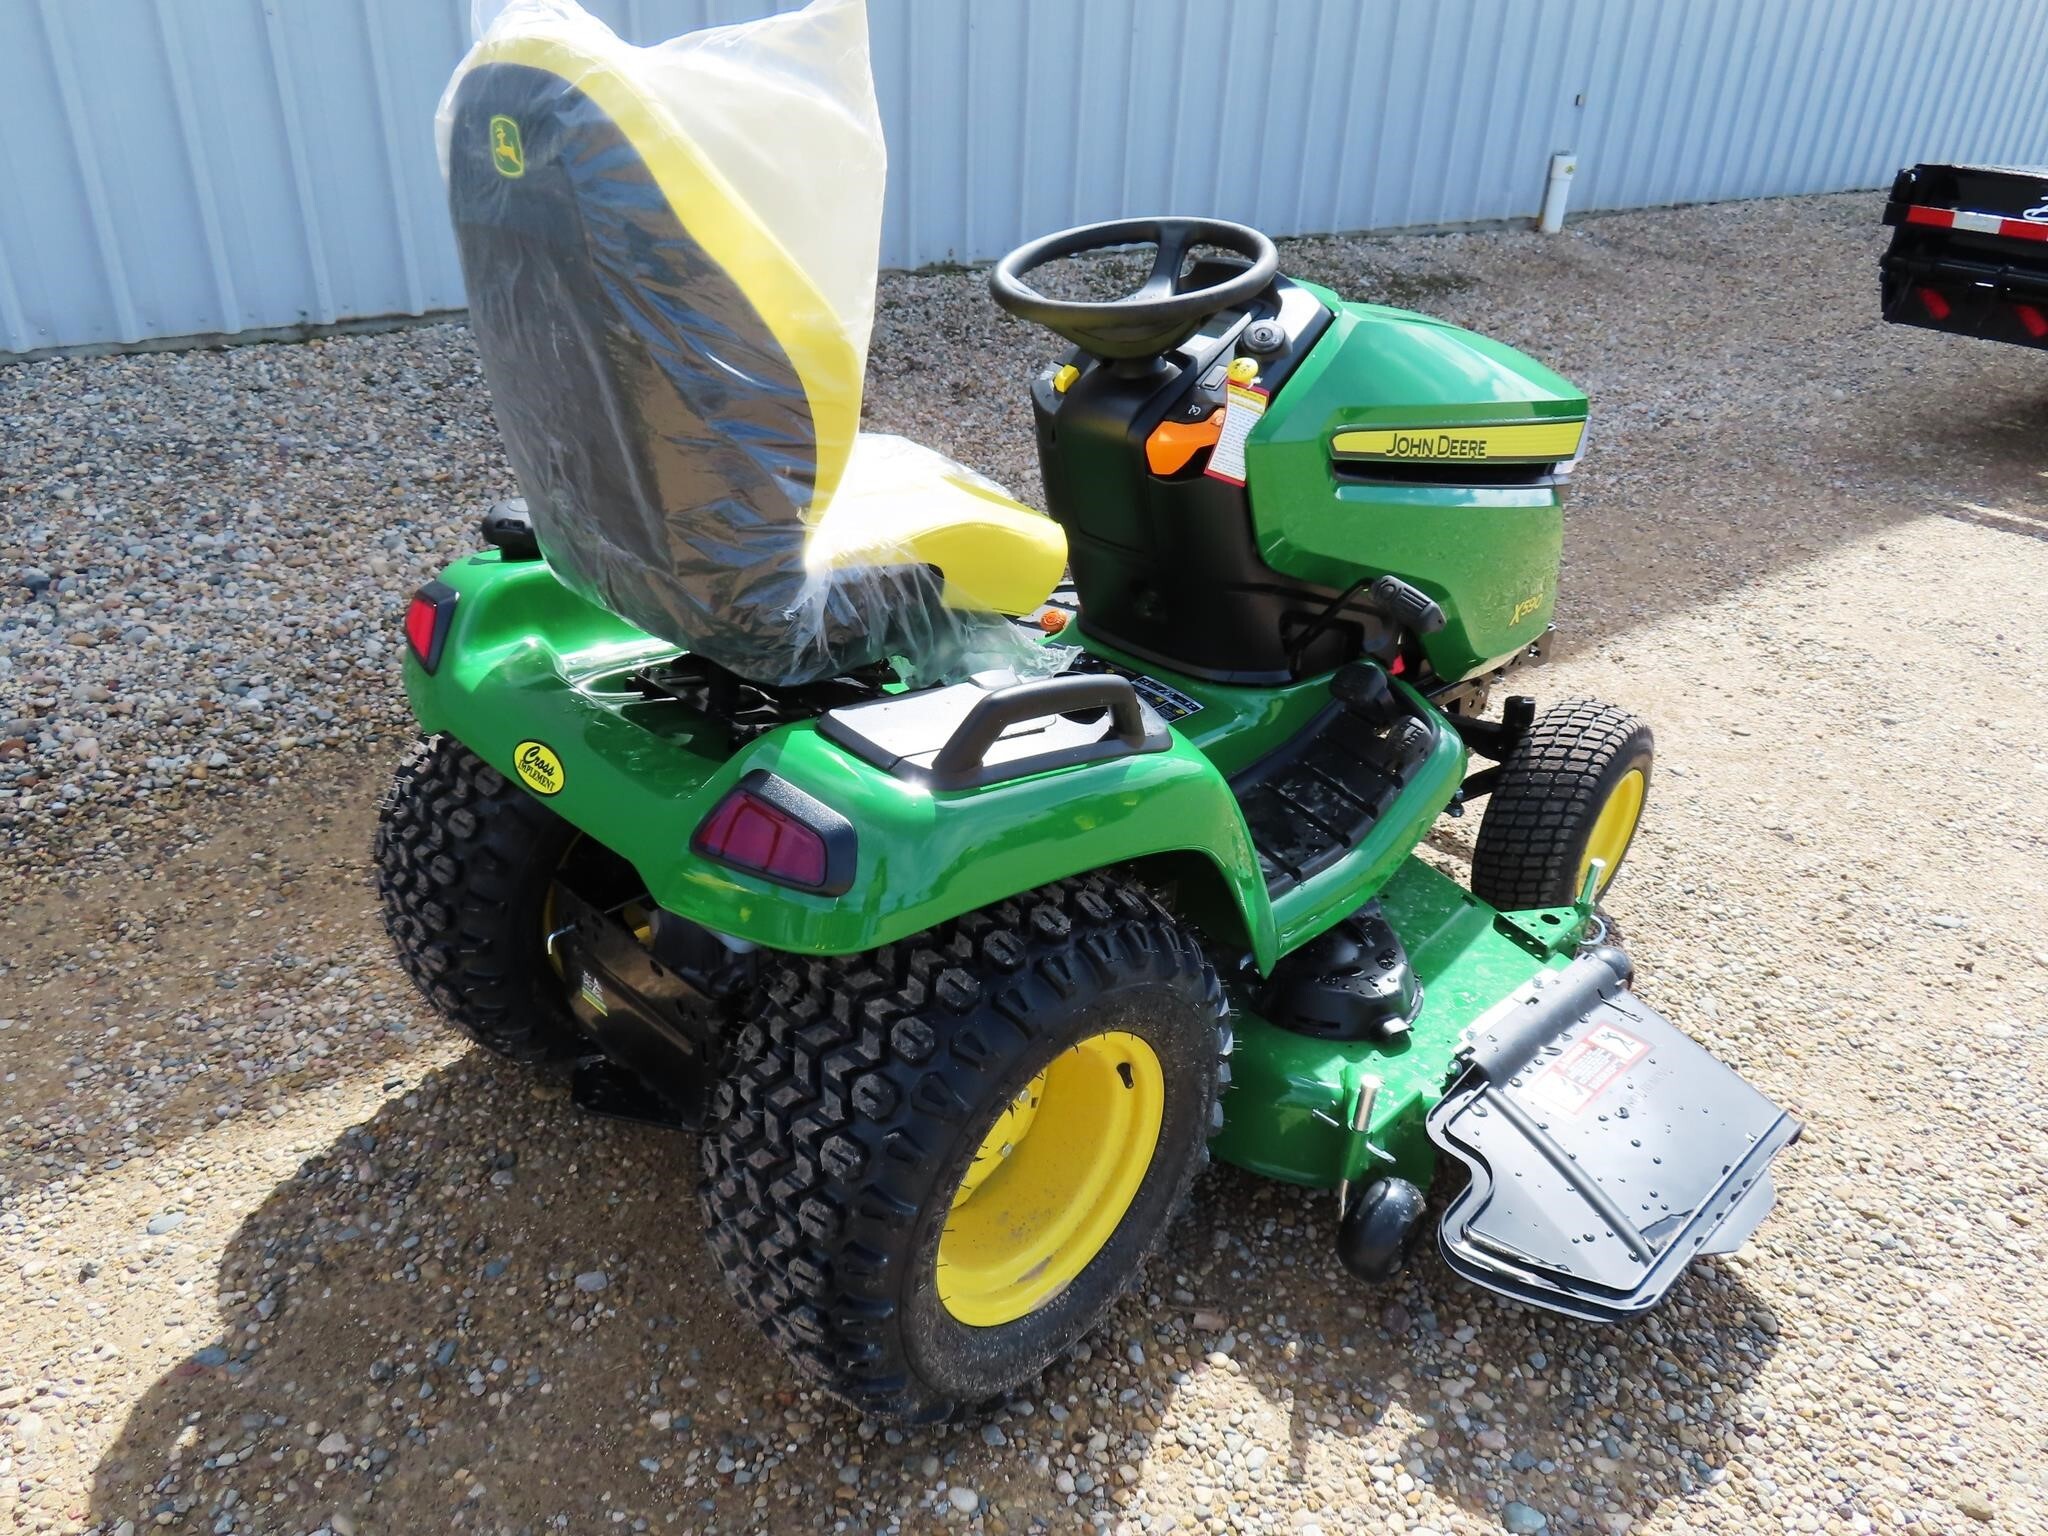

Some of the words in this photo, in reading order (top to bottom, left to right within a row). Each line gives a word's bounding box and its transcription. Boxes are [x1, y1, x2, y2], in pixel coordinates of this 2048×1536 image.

[1386, 432, 1434, 456] JOHN
[1437, 434, 1487, 457] DEERE
[518, 759, 556, 792] IMPLEMENT
[522, 745, 555, 777] Cross
